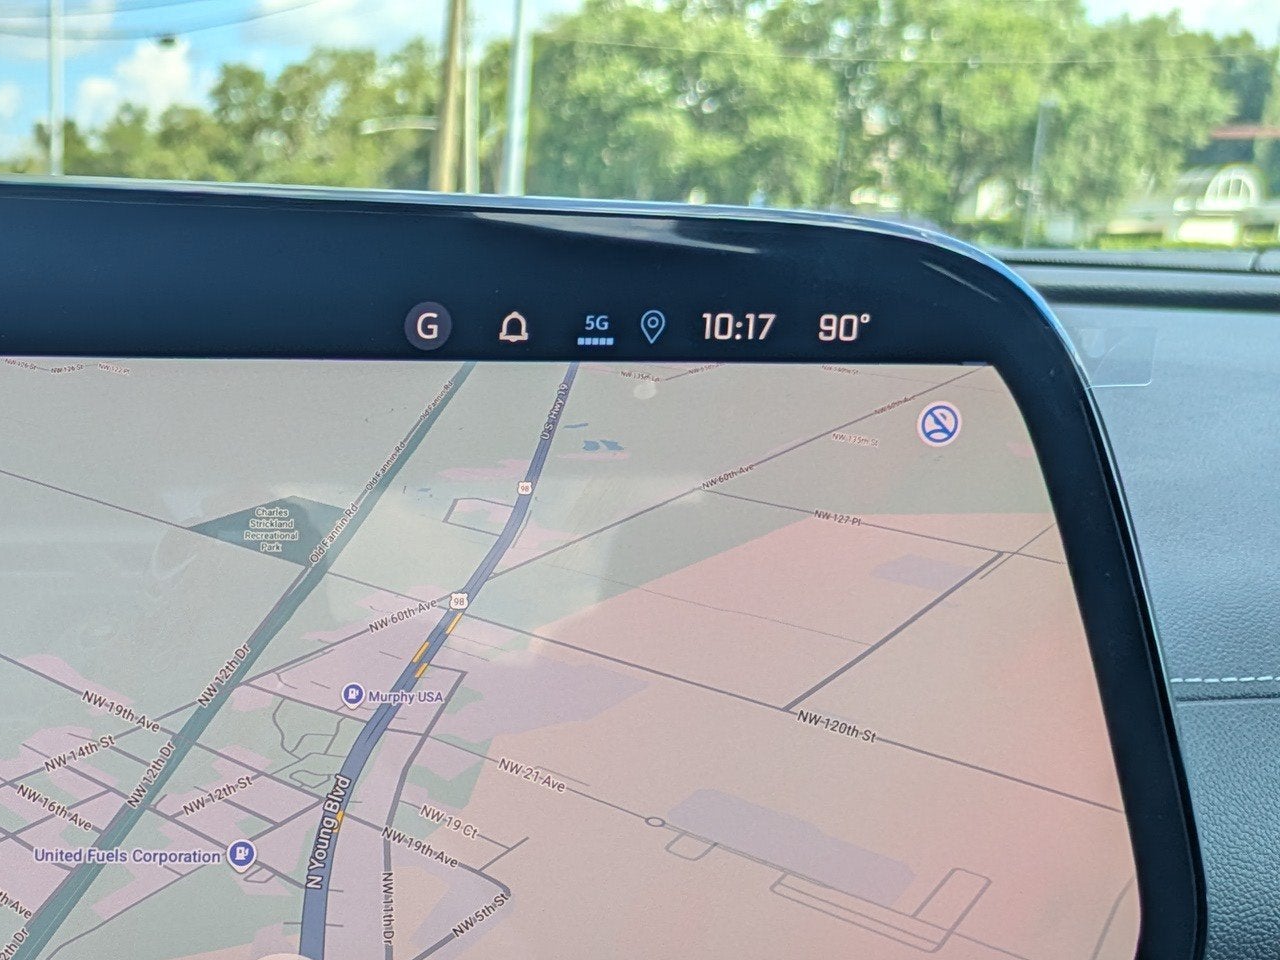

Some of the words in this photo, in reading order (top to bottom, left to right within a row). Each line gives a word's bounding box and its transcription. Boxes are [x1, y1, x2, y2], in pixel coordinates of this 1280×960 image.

[417, 313, 438, 339] G
[584, 315, 609, 331] 5G
[702, 313, 777, 341] 10:17
[819, 313, 871, 341] 90°
[549, 398, 565, 420] Hwy
[558, 383, 568, 398] 19
[250, 520, 293, 528] Strickland
[256, 508, 288, 516] Charles
[815, 510, 830, 520] NW
[833, 514, 850, 523] 127
[851, 518, 861, 526] Pl
[244, 531, 298, 540] Recreational
[310, 545, 326, 563] Old
[322, 516, 349, 548] Fannin
[346, 502, 359, 518] Rd
[262, 543, 282, 552] Park
[369, 618, 389, 632] NW
[391, 608, 416, 624] 60th
[417, 600, 437, 612] Ave
[454, 598, 464, 606] 98
[198, 687, 218, 706] NW
[215, 658, 238, 686] 12th
[234, 644, 250, 660] Dr
[82, 690, 104, 708] NW
[107, 703, 134, 721] 19th
[136, 715, 160, 732] Ave
[369, 691, 414, 703] Murphy
[418, 692, 443, 702] USA
[797, 709, 820, 728] NW
[823, 717, 859, 740] 120th
[861, 728, 877, 743] St
[44, 756, 66, 772] NW
[70, 744, 98, 760] 14th
[100, 736, 115, 748] St
[127, 788, 147, 808] NW
[143, 758, 166, 786] 12th
[160, 742, 176, 758] Dr
[498, 758, 520, 775] NW
[523, 770, 539, 780] 21
[540, 774, 565, 792] Ave
[17, 784, 39, 802] NW
[42, 795, 69, 818] 16th
[69, 813, 92, 831] Ave
[182, 800, 205, 815] NW
[207, 786, 234, 802] 12th
[236, 776, 252, 789] St
[324, 775, 351, 811] Blvd
[420, 805, 442, 821] NW
[446, 818, 462, 830] 19
[462, 826, 478, 839] Ct
[34, 849, 82, 862] United
[87, 850, 127, 862] Fuels
[132, 850, 220, 864] Corporation
[308, 815, 340, 871] Young
[382, 827, 404, 843] NW
[407, 836, 433, 855] 19th
[434, 851, 459, 868] Ave
[306, 877, 322, 888] N
[382, 872, 394, 895] NW
[9, 900, 32, 920] Ave
[383, 897, 394, 928] 11th
[452, 917, 475, 938] NW
[474, 904, 496, 924] 5th
[493, 894, 509, 908] St
[12, 928, 28, 945] Dr
[384, 930, 394, 945] Dr
